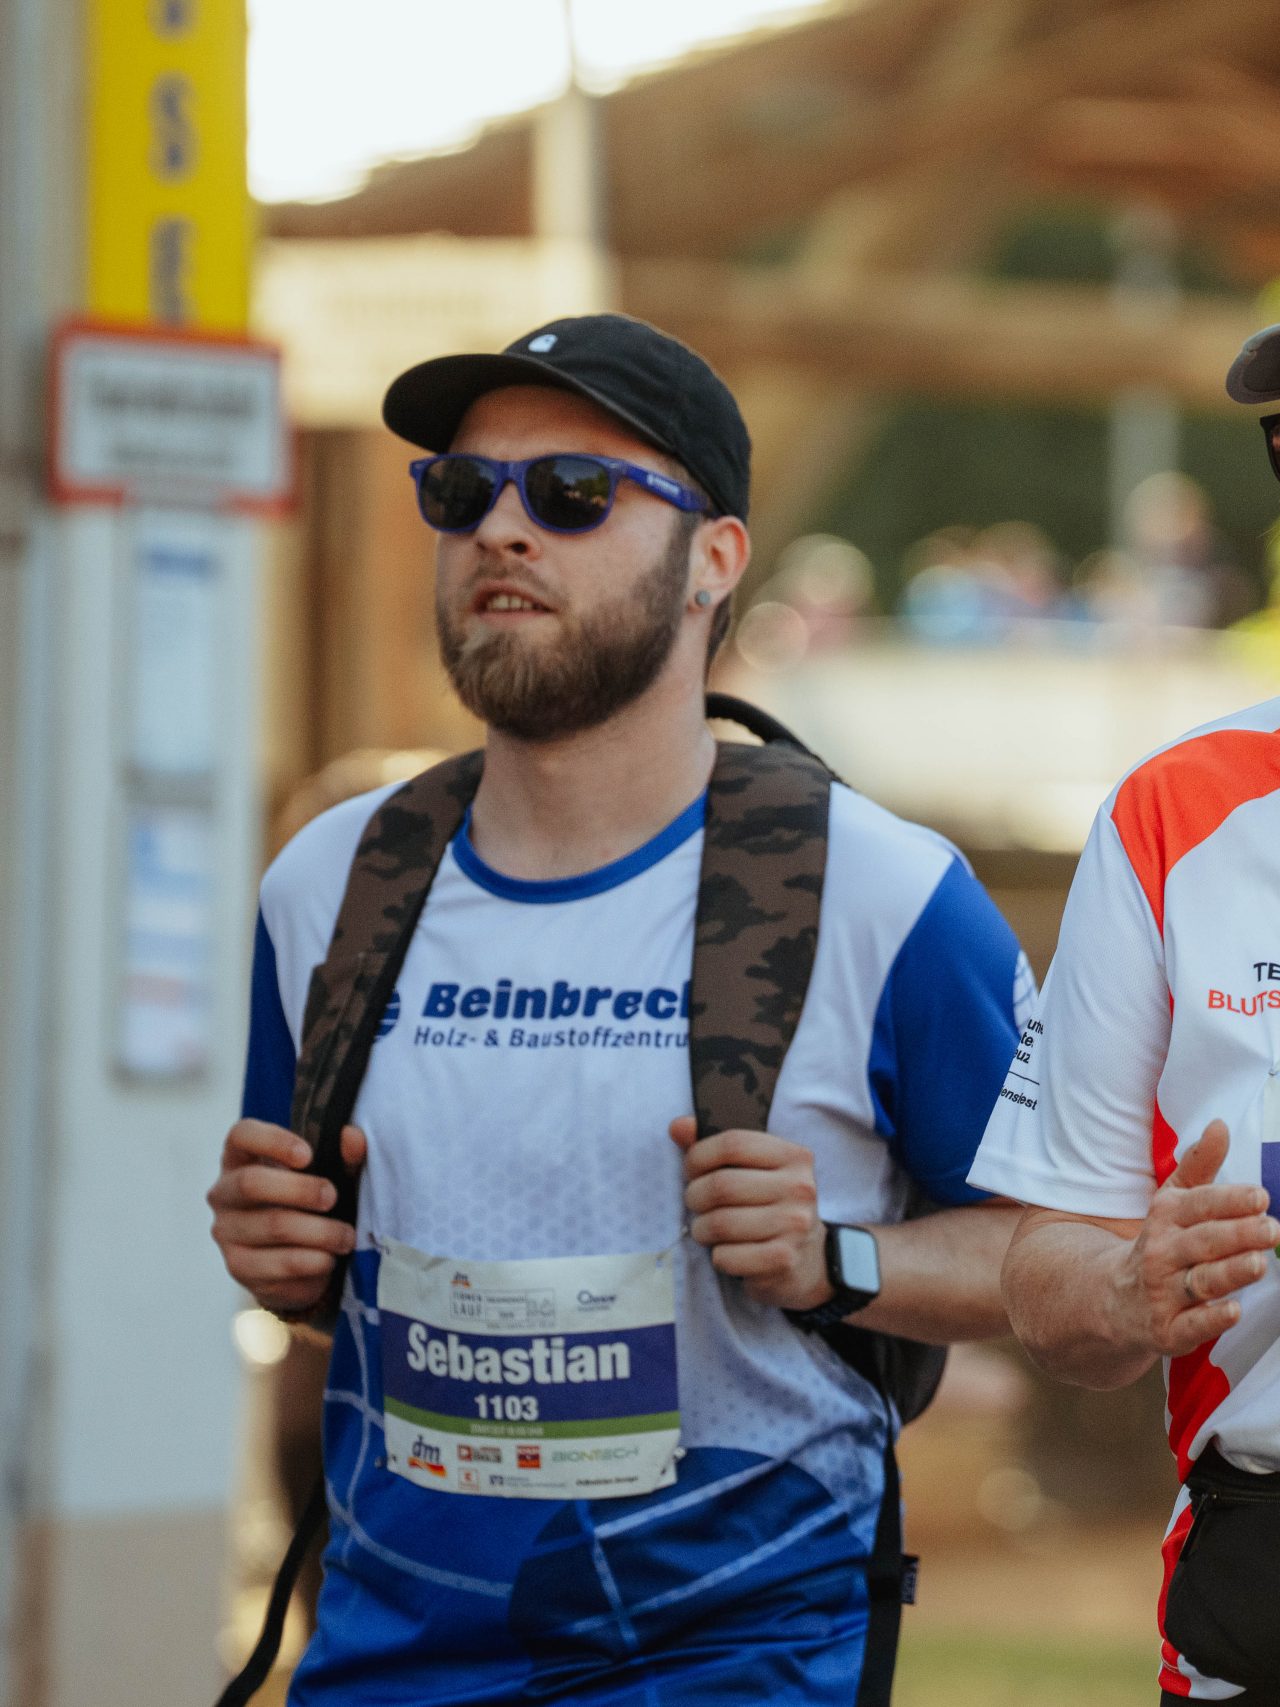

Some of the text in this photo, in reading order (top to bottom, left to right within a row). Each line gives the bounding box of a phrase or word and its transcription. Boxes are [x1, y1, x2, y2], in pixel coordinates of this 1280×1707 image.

[414, 1026, 477, 1047] Holz-
[484, 1029, 499, 1046] &
[407, 1322, 631, 1385] Sebastian
[474, 1393, 539, 1421] 1103
[412, 1435, 441, 1465] dm
